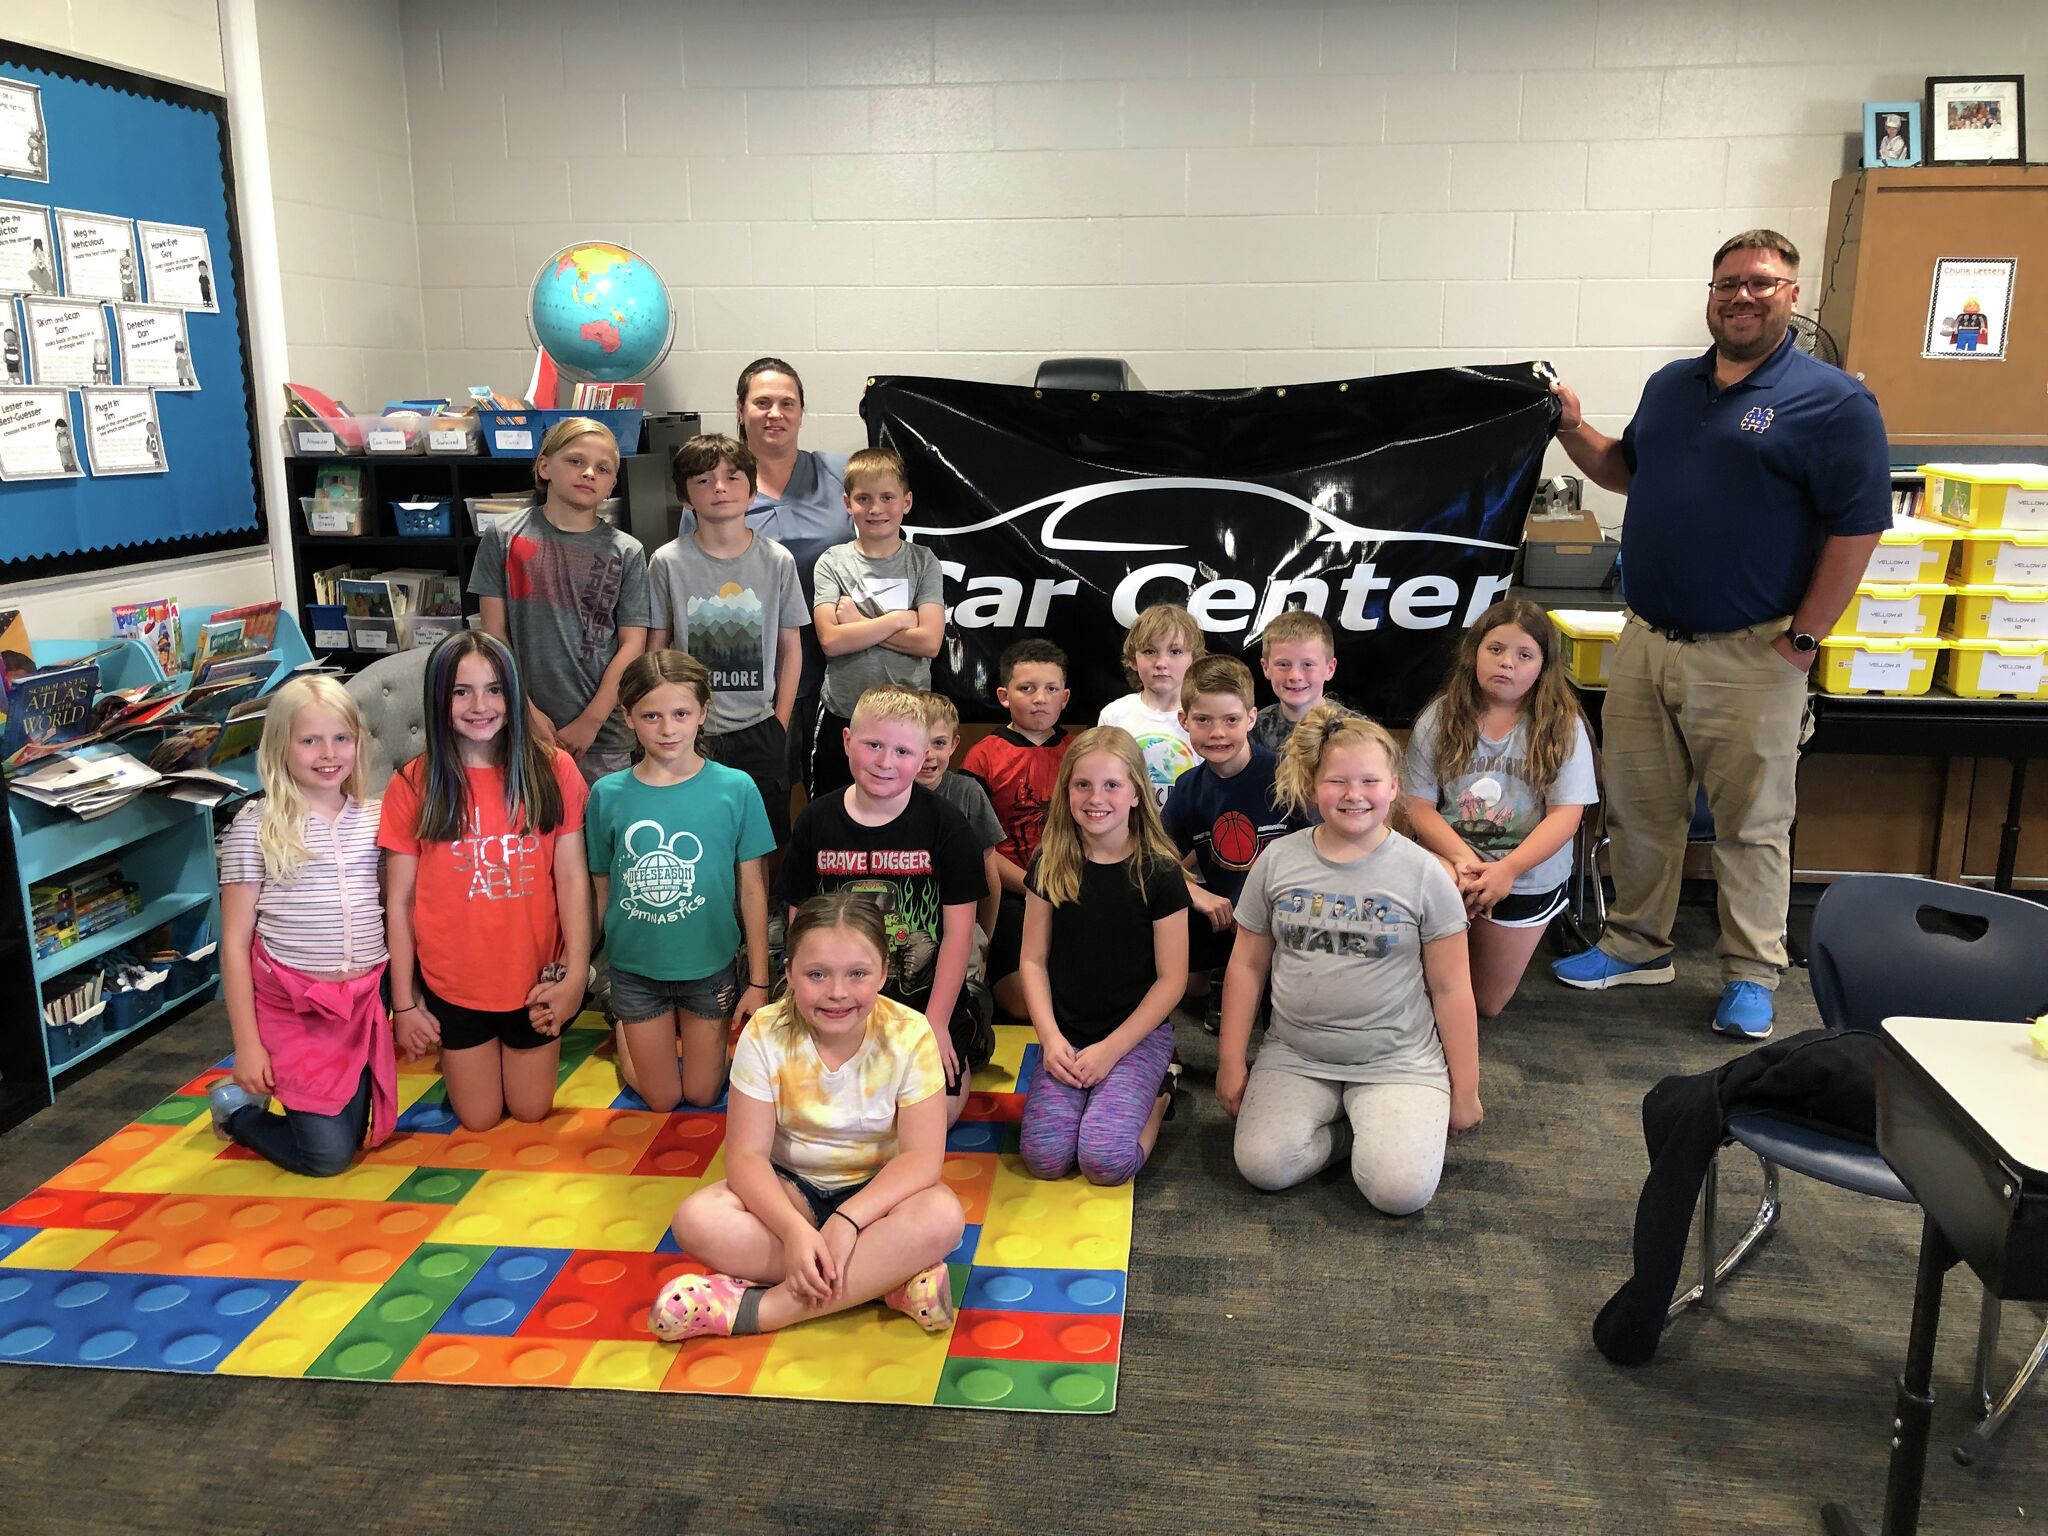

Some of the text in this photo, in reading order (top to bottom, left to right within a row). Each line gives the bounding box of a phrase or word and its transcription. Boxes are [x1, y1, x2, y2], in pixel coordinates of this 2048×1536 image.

[73, 230, 87, 239] Meg
[71, 238, 105, 250] Meticulous
[1943, 266, 2007, 276] Chunk Letters
[36, 317, 53, 328] Skim
[63, 311, 81, 321] Scan
[126, 318, 155, 330] Detective
[54, 326, 70, 335] Sam
[137, 330, 150, 339] Dan
[1, 402, 23, 414] Lester
[103, 412, 116, 421] Tim
[2018, 499, 2045, 507] YELLOW
[1111, 562, 1514, 640] Center
[707, 670, 760, 687] PLORE
[25, 682, 89, 712] ATLAS
[22, 705, 86, 736] WORLD
[450, 834, 540, 872] STOPP
[816, 849, 932, 871] GRAVE DIGGER
[628, 866, 693, 884] OFF-SEASON
[1278, 887, 1400, 925] STAR
[1276, 919, 1399, 959] WARS
